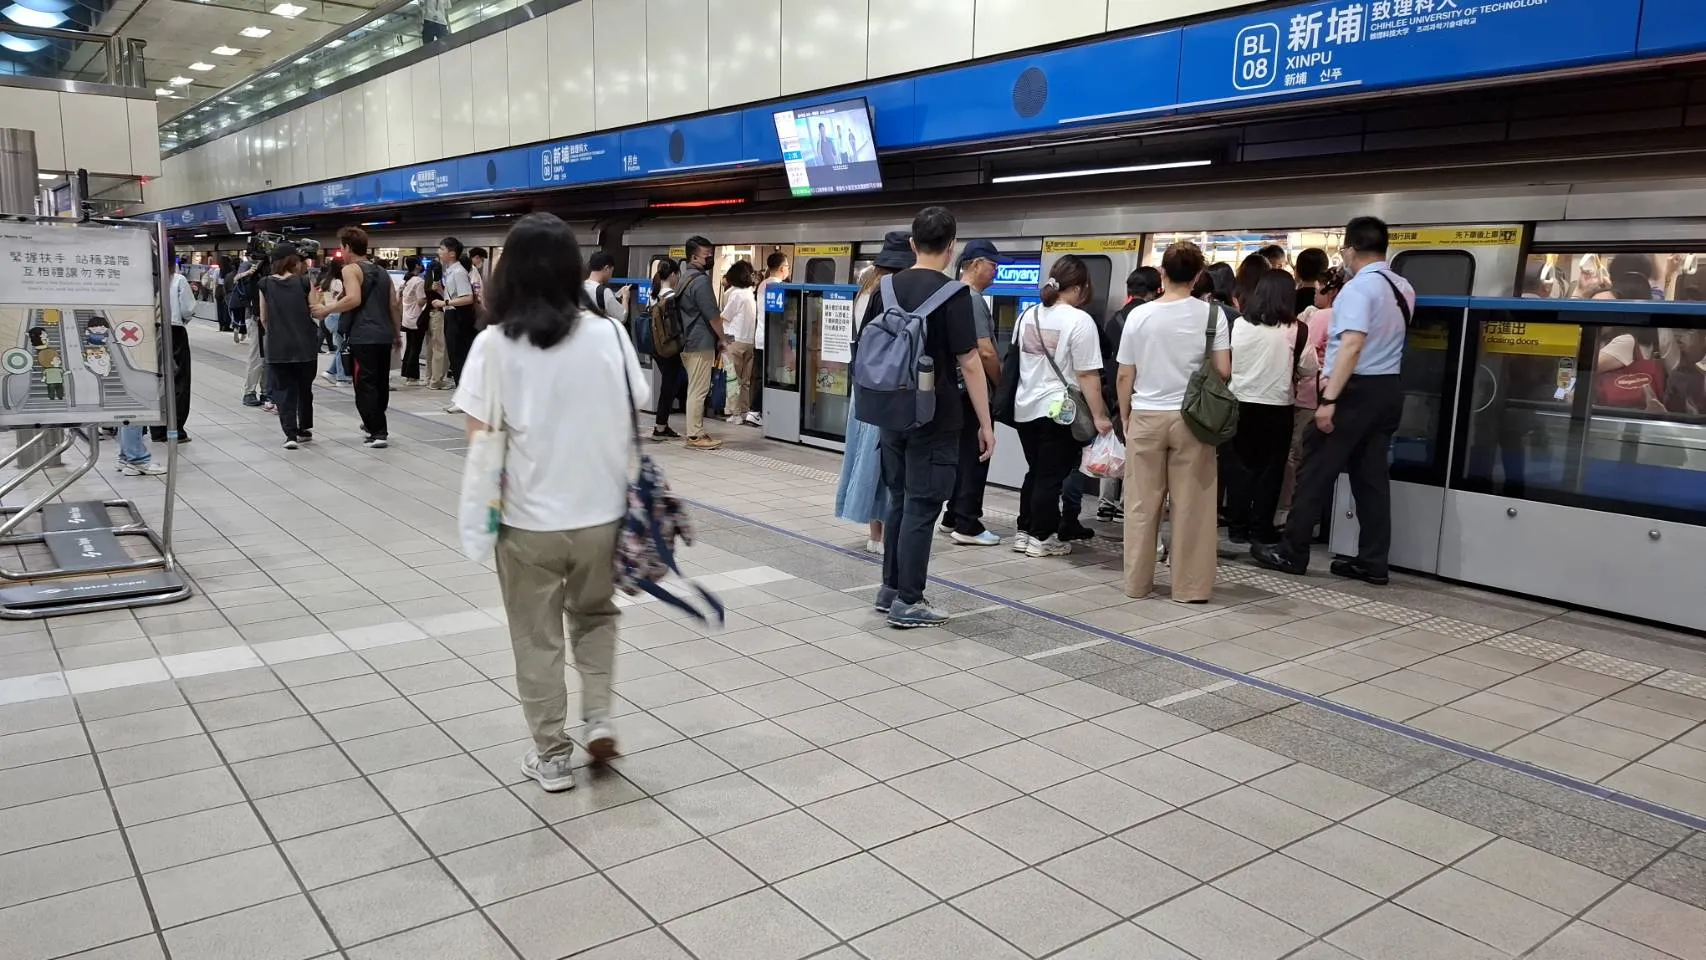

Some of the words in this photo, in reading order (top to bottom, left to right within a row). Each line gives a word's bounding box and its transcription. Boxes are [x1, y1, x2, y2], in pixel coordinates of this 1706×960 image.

[1287, 3, 1363, 51] 新埔
[1371, 19, 1408, 31] CHIHLEE
[1410, 9, 1462, 25] UNIVERSITY
[1464, 7, 1479, 16] OF
[1243, 34, 1271, 56] BL
[1243, 58, 1267, 80] 08
[1286, 51, 1332, 70] XINPU
[1284, 72, 1307, 86] 新埔
[1320, 68, 1342, 82] 신푸
[10, 251, 64, 264] 緊握扶手
[998, 265, 1039, 283] Kunyang
[776, 292, 783, 309] 4
